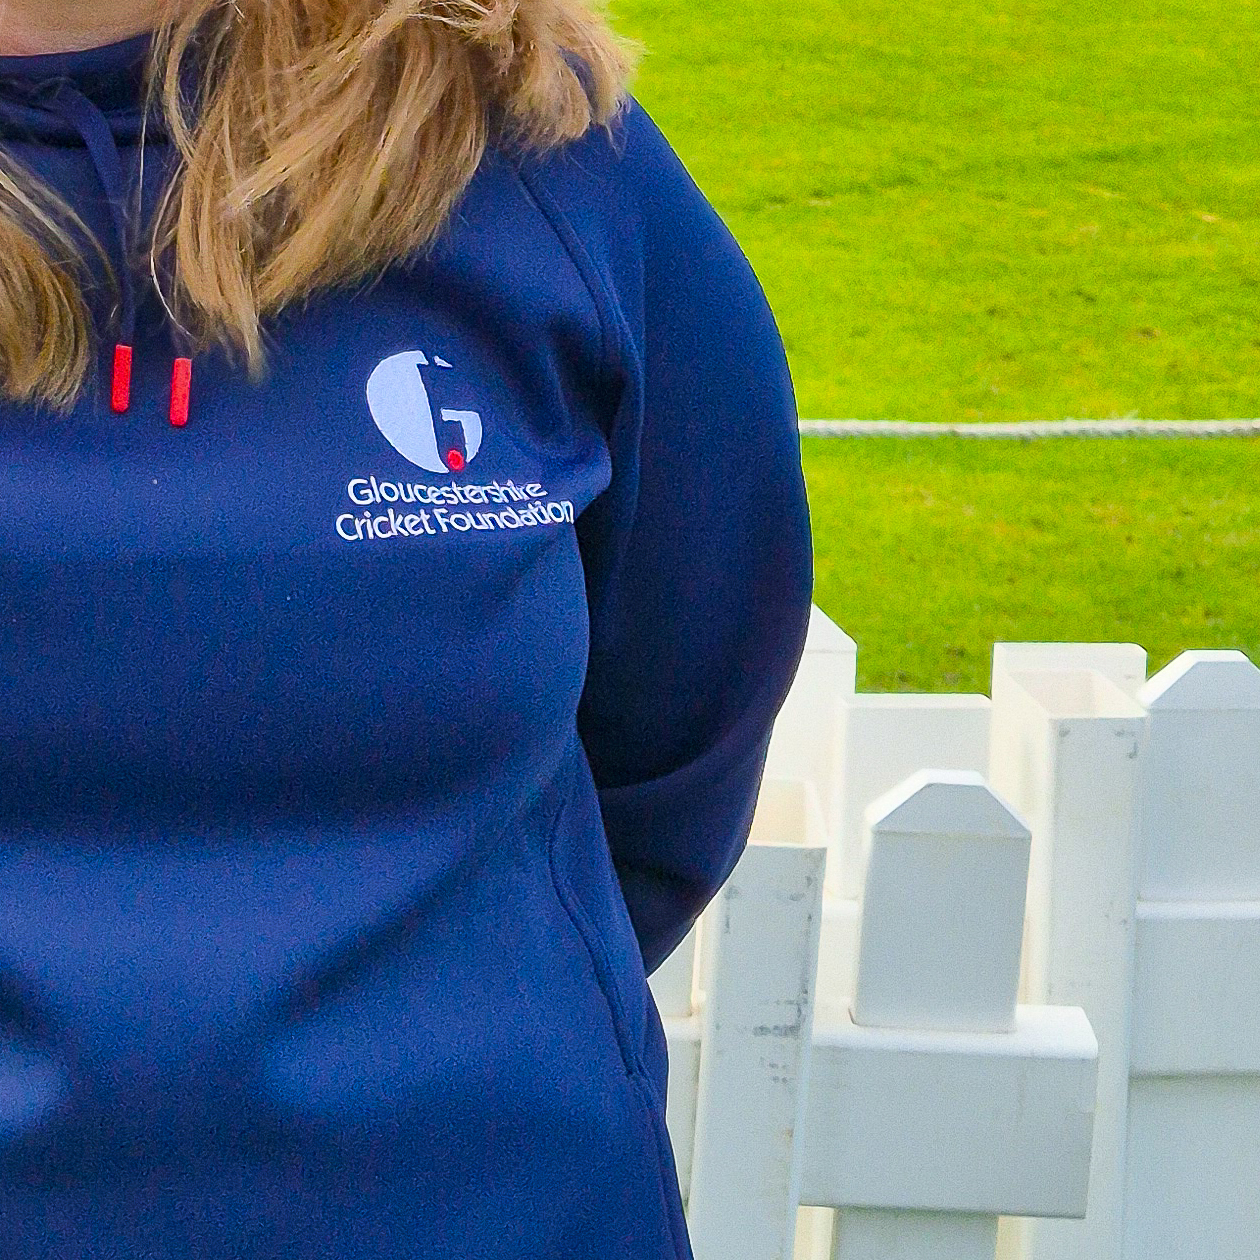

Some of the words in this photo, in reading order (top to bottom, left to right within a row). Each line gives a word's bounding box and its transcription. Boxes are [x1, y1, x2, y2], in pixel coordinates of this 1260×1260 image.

[347, 476, 548, 505] Gloucestershire
[335, 509, 437, 541] Cricket
[433, 500, 575, 534] Foundation
